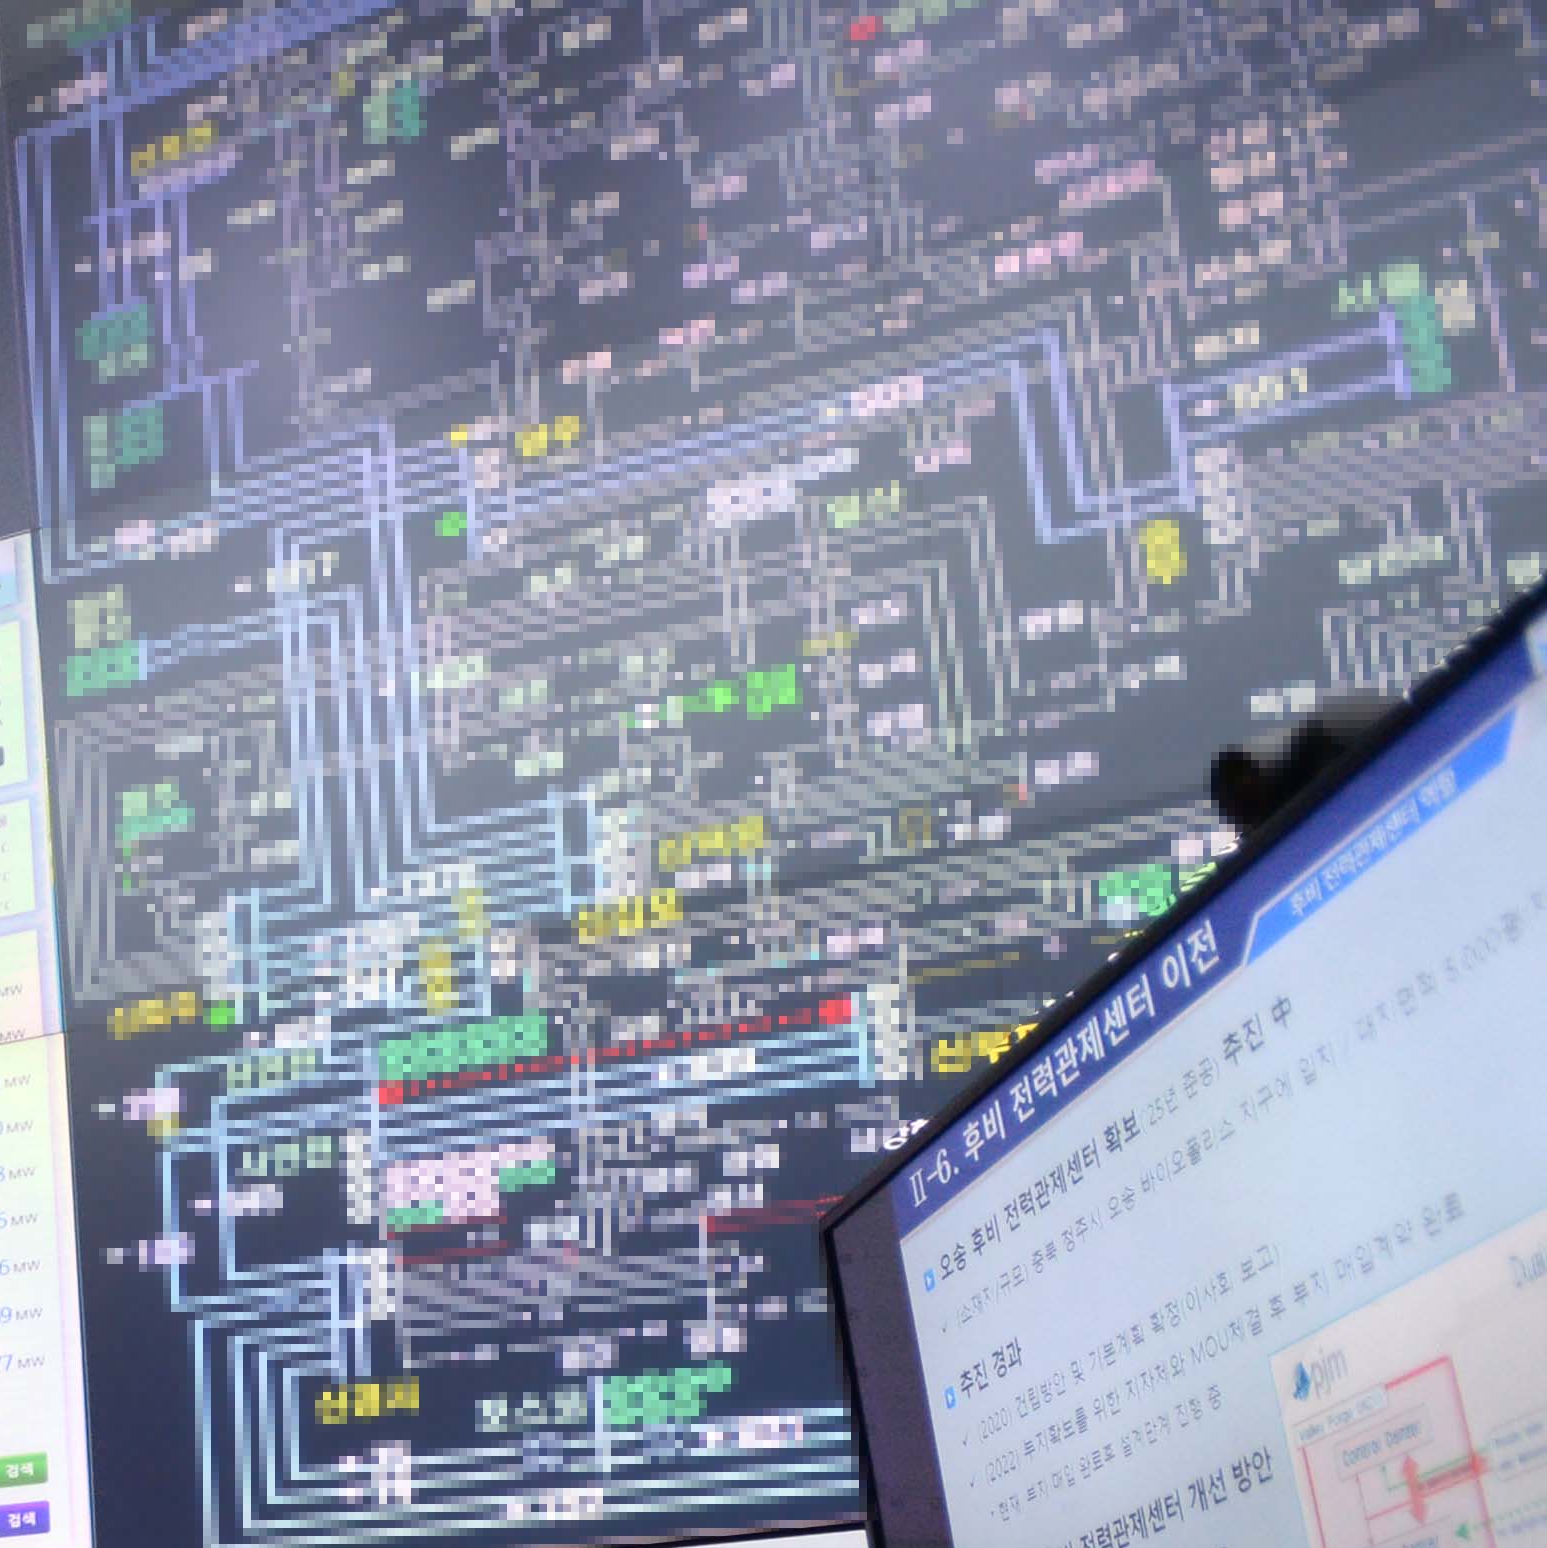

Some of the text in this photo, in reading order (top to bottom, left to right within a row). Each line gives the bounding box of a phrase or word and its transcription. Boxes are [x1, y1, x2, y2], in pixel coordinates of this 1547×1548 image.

[0, 1028, 26, 1042] MW
[963, 1100, 1006, 1163] 후비
[1010, 973, 1155, 1123] 전력관제센터
[1162, 920, 1220, 989] 이전
[4, 1074, 31, 1090] MW
[6, 1120, 33, 1134] MW
[939, 1242, 967, 1281] 오송
[971, 1215, 1002, 1257] 후비
[1004, 1138, 1101, 1232] 전력관제센터
[1223, 1012, 1265, 1066] 추진
[8, 1166, 36, 1181] MW
[10, 1212, 38, 1227] MW
[13, 1260, 40, 1274] MW
[15, 1307, 43, 1322] MW
[16, 1355, 45, 1370] MW
[959, 1336, 1022, 1398] 추진 경과
[1311, 1348, 1348, 1398] pjm
[5, 1463, 34, 1478] 검색
[1188, 1467, 1227, 1513] 개선
[1232, 1445, 1274, 1493] 방안
[8, 1512, 36, 1528] 검색
